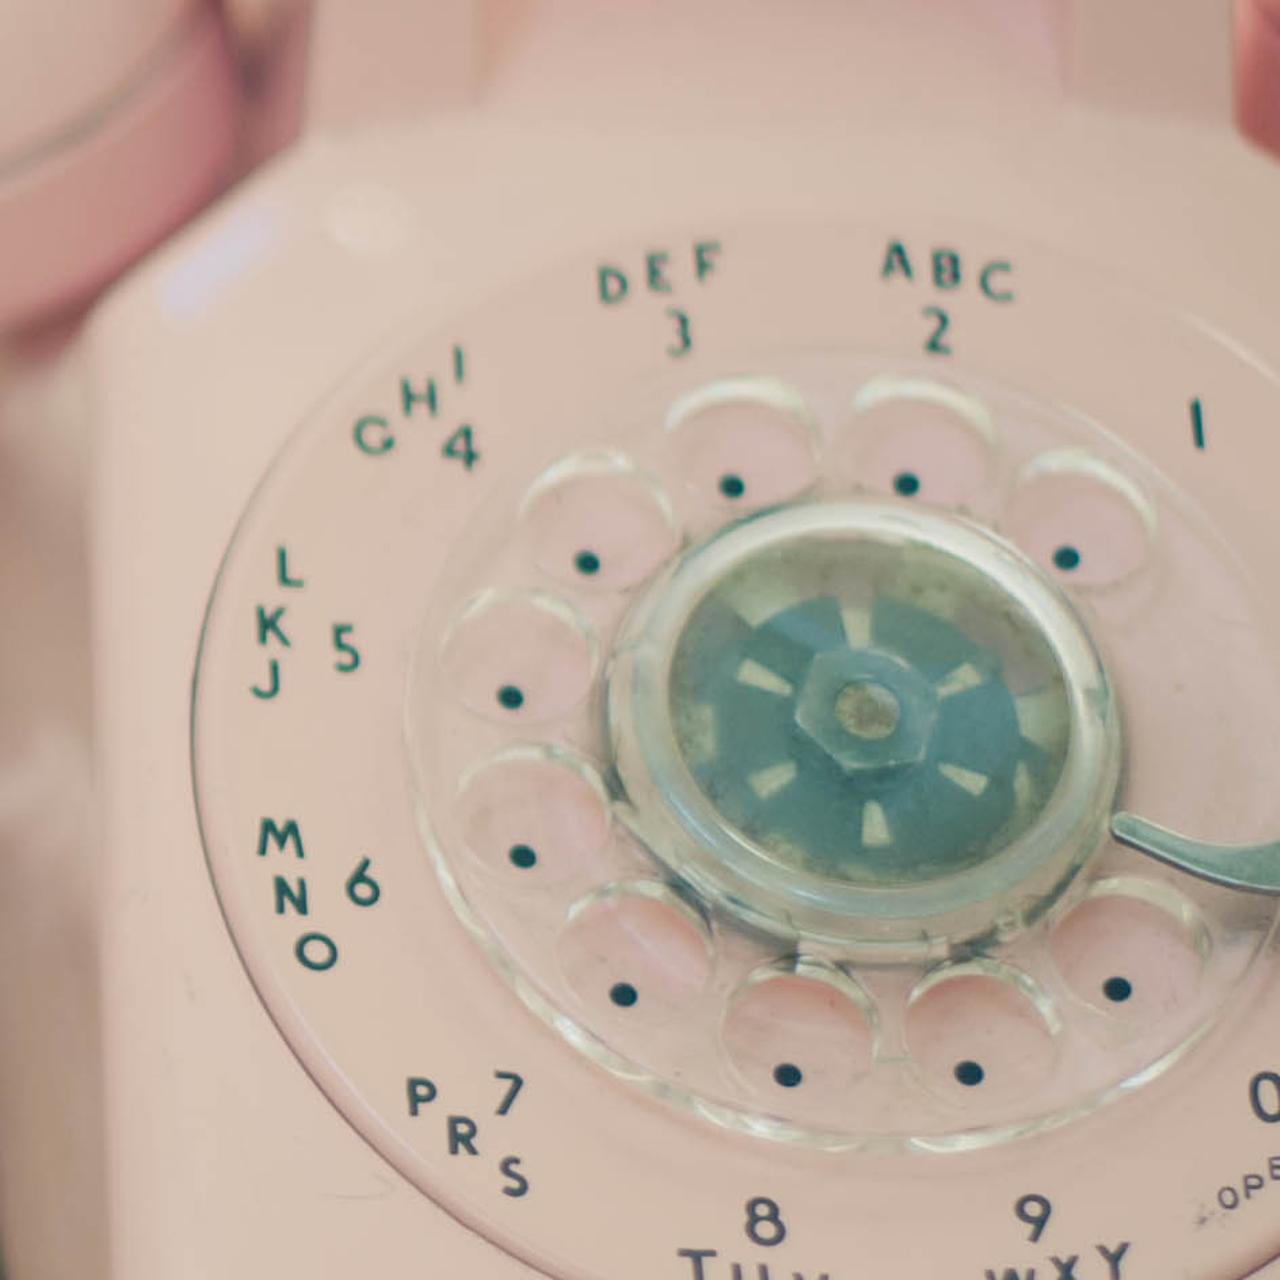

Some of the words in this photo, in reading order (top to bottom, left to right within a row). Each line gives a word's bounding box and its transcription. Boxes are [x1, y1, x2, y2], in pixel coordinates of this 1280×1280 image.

[596, 241, 722, 305] DEF
[881, 240, 1014, 302] ABC
[667, 310, 692, 357] 3
[922, 307, 951, 355] 2
[441, 424, 479, 470] 4
[332, 623, 361, 673] 5
[346, 857, 381, 908] 6
[494, 1070, 525, 1116] 7
[744, 1196, 787, 1247] 8
[1014, 1193, 1052, 1243] 9
